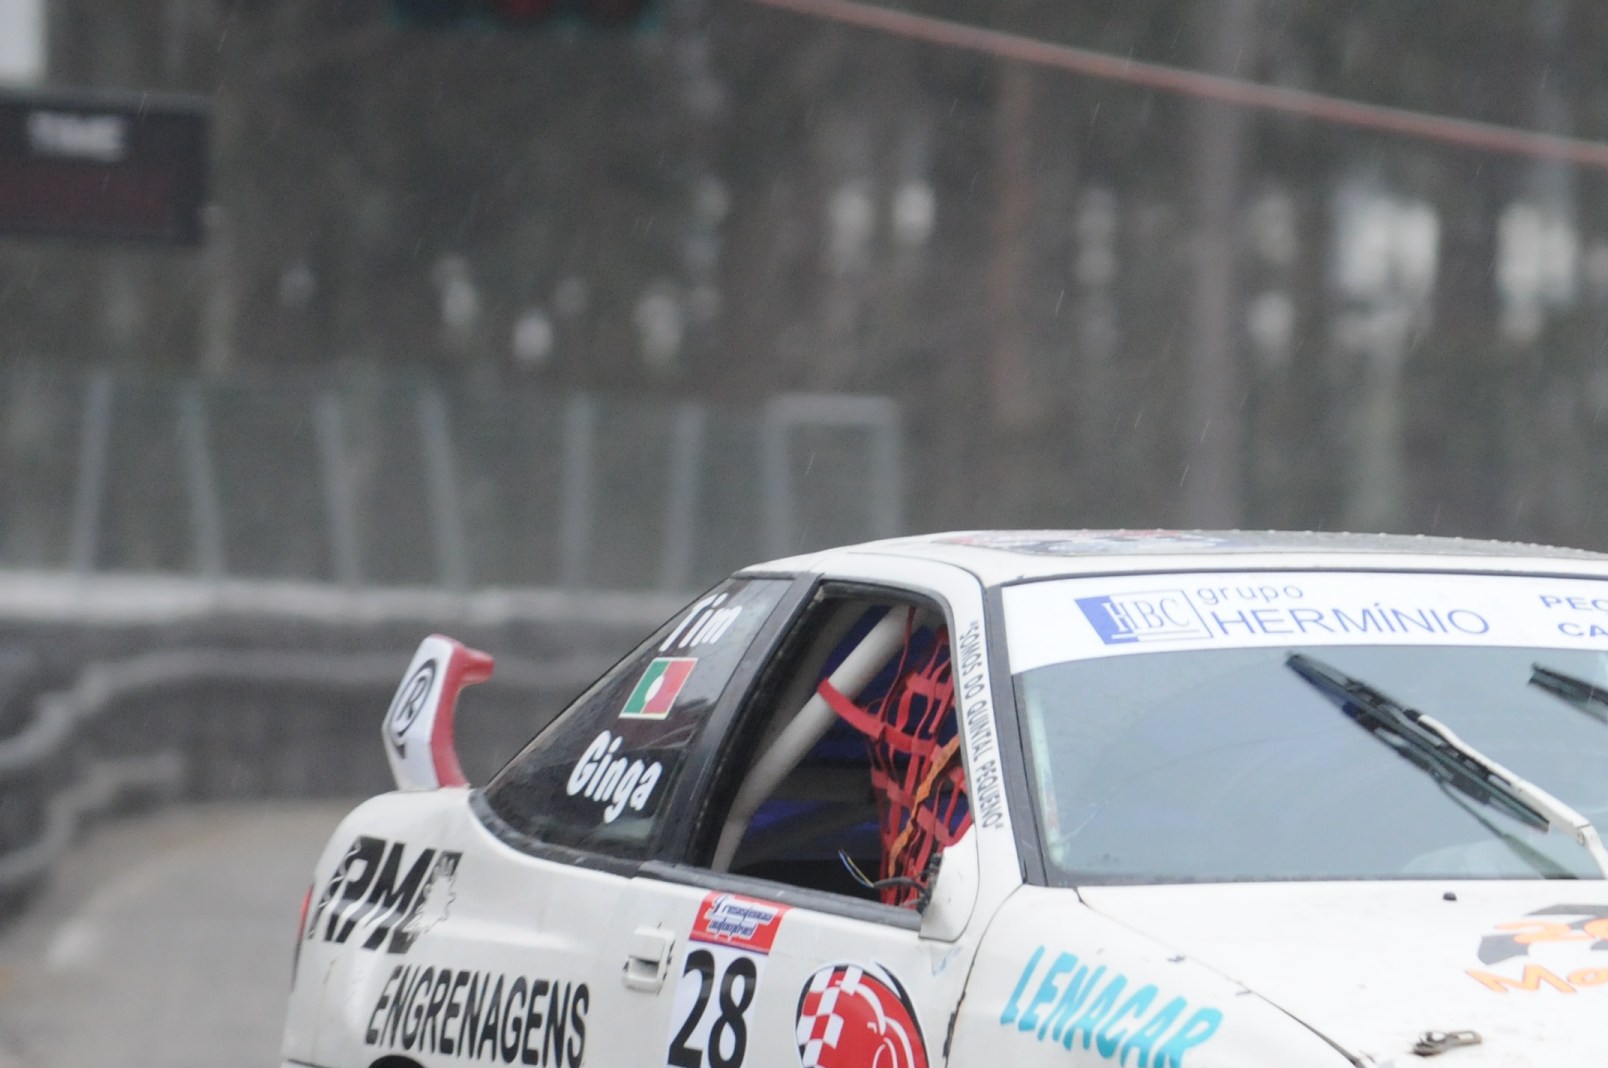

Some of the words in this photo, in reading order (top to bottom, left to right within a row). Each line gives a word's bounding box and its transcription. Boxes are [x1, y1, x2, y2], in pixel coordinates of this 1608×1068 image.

[658, 592, 743, 653] Tim
[1196, 585, 1304, 606] grupo
[1209, 602, 1491, 636] HERMÍNIO
[966, 699, 994, 763] QUINTAL
[565, 729, 664, 825] Ginga
